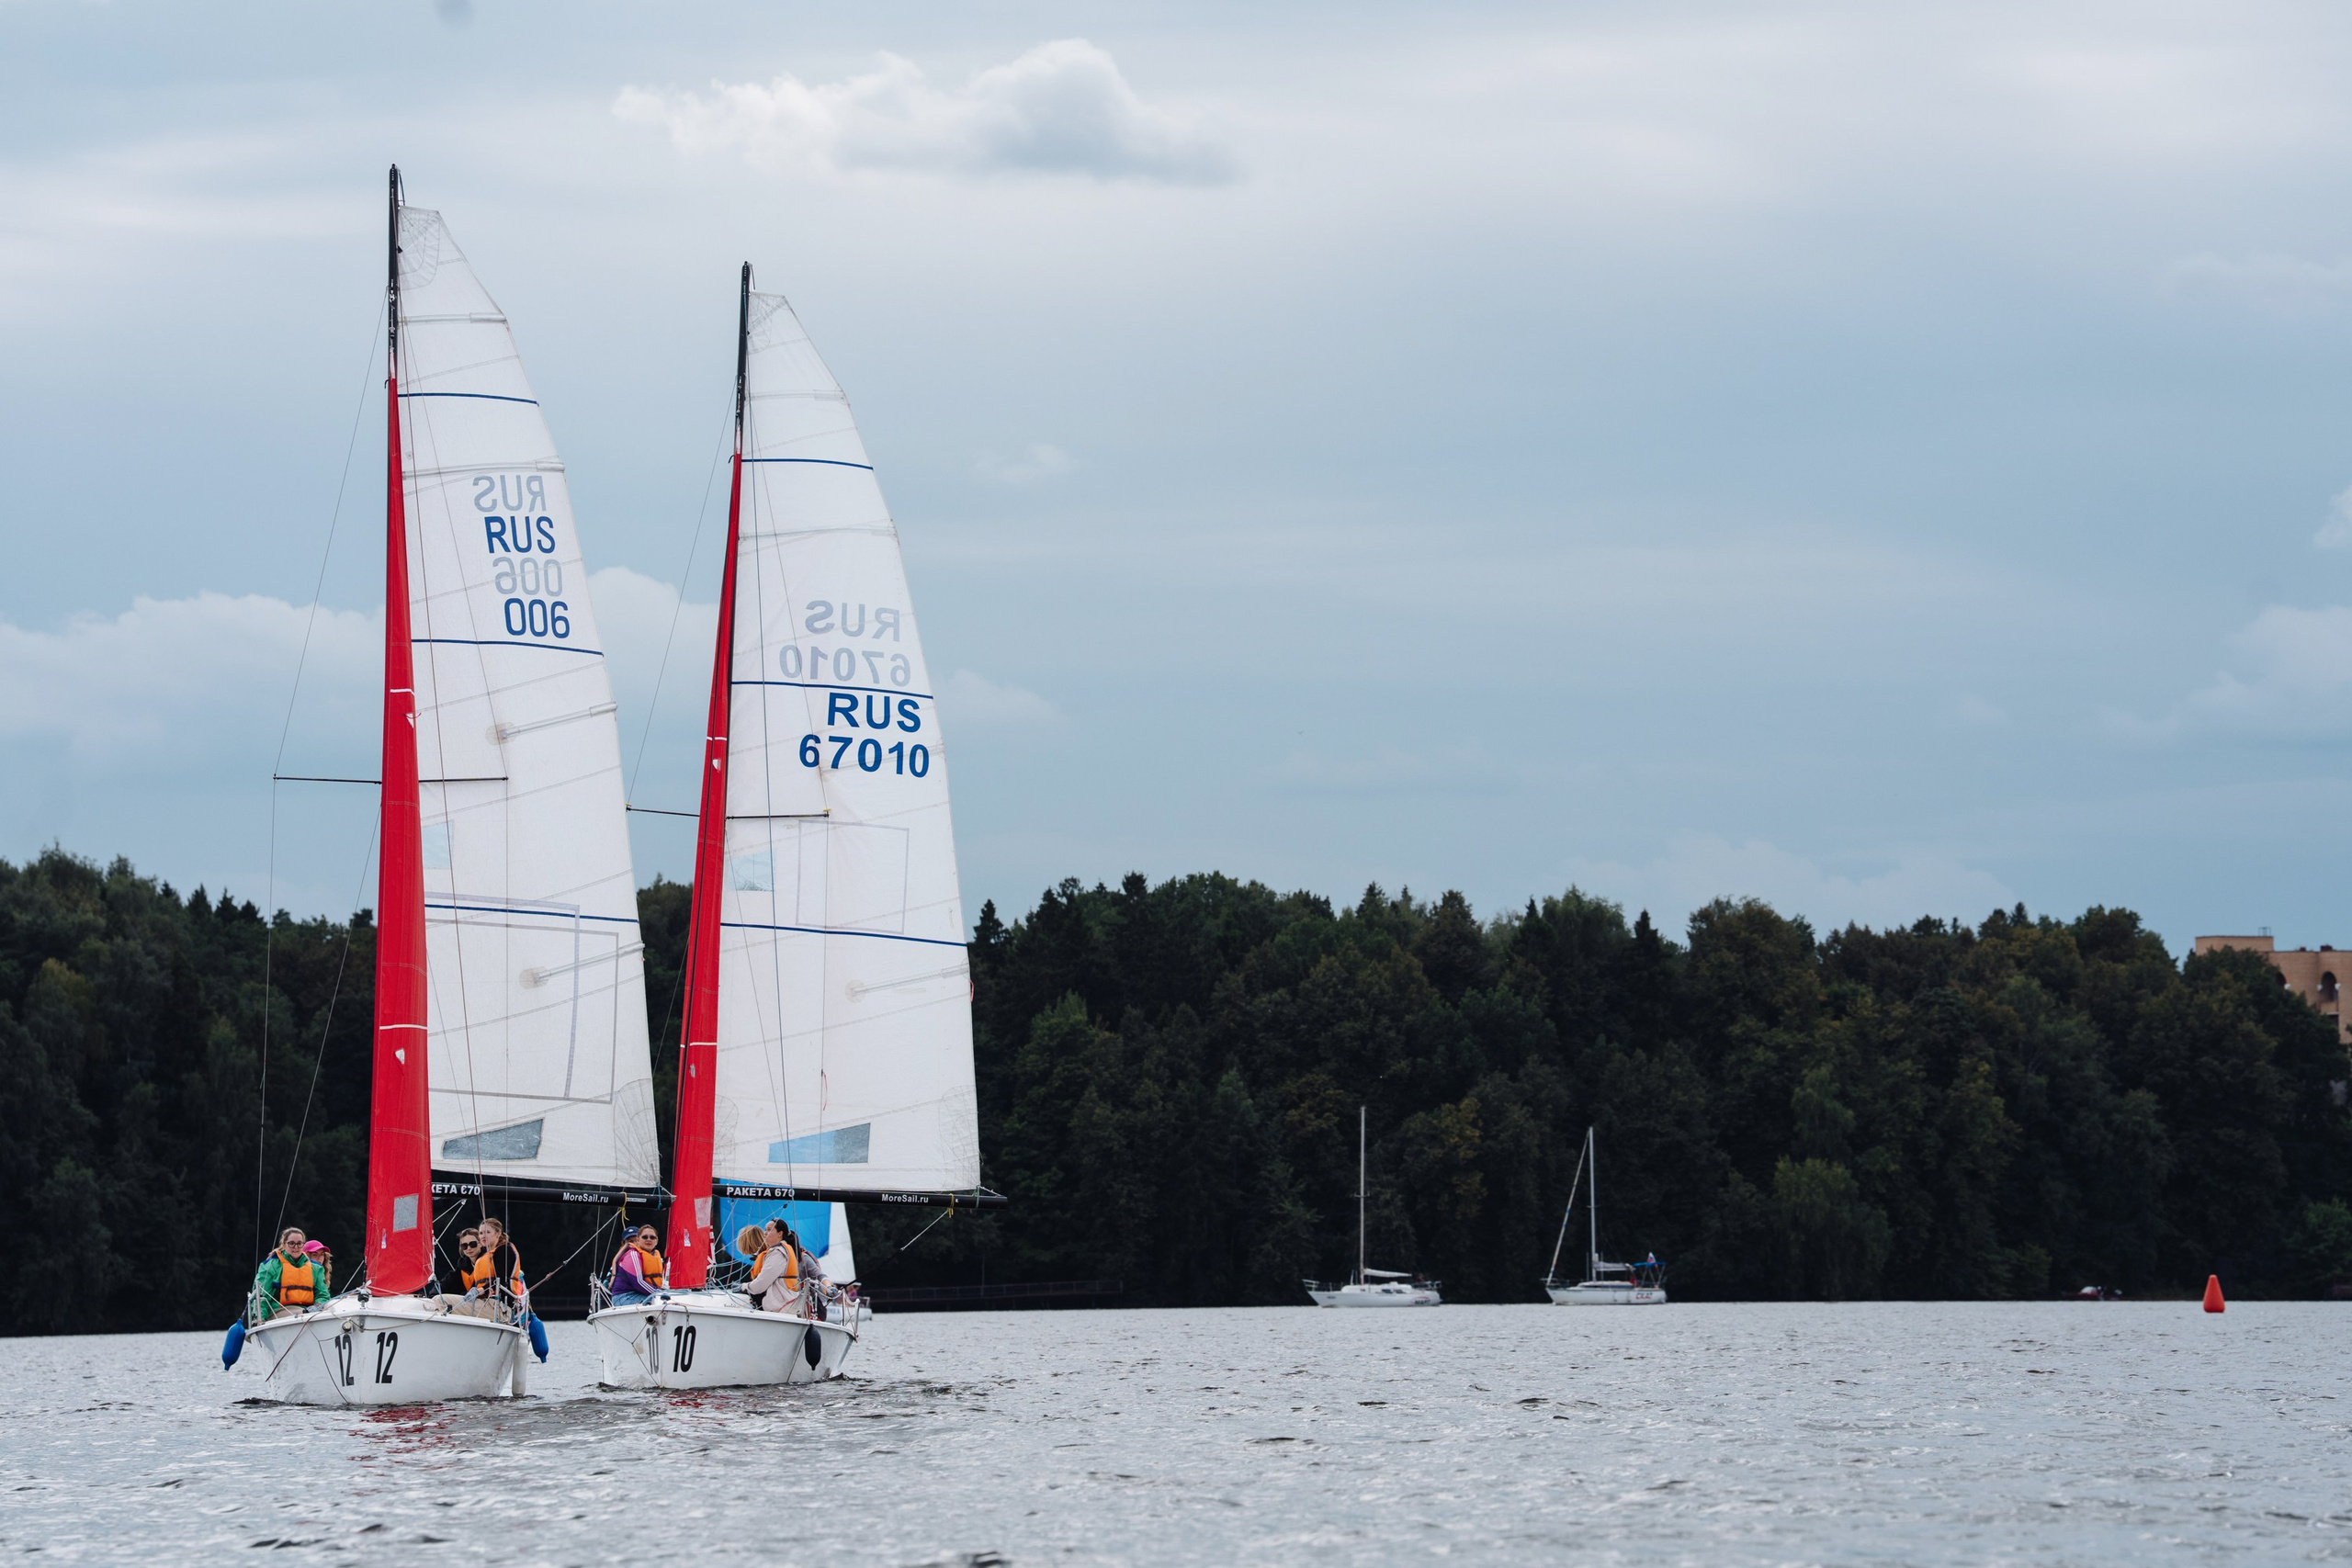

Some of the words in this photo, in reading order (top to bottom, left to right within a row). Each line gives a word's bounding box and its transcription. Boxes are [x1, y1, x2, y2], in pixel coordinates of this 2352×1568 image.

[484, 516, 556, 554] RUS
[503, 598, 571, 638] 006
[827, 692, 922, 733] RUS
[799, 734, 930, 778] 67010
[563, 1192, 609, 1203] MoreSail.ru
[726, 1187, 772, 1197] РАКЕТА
[775, 1188, 796, 1198] 670
[882, 1193, 929, 1203] MoreSail.ru
[334, 1334, 355, 1387] 12
[375, 1332, 399, 1384] 12
[646, 1326, 660, 1374] 10
[673, 1325, 696, 1372] 10
